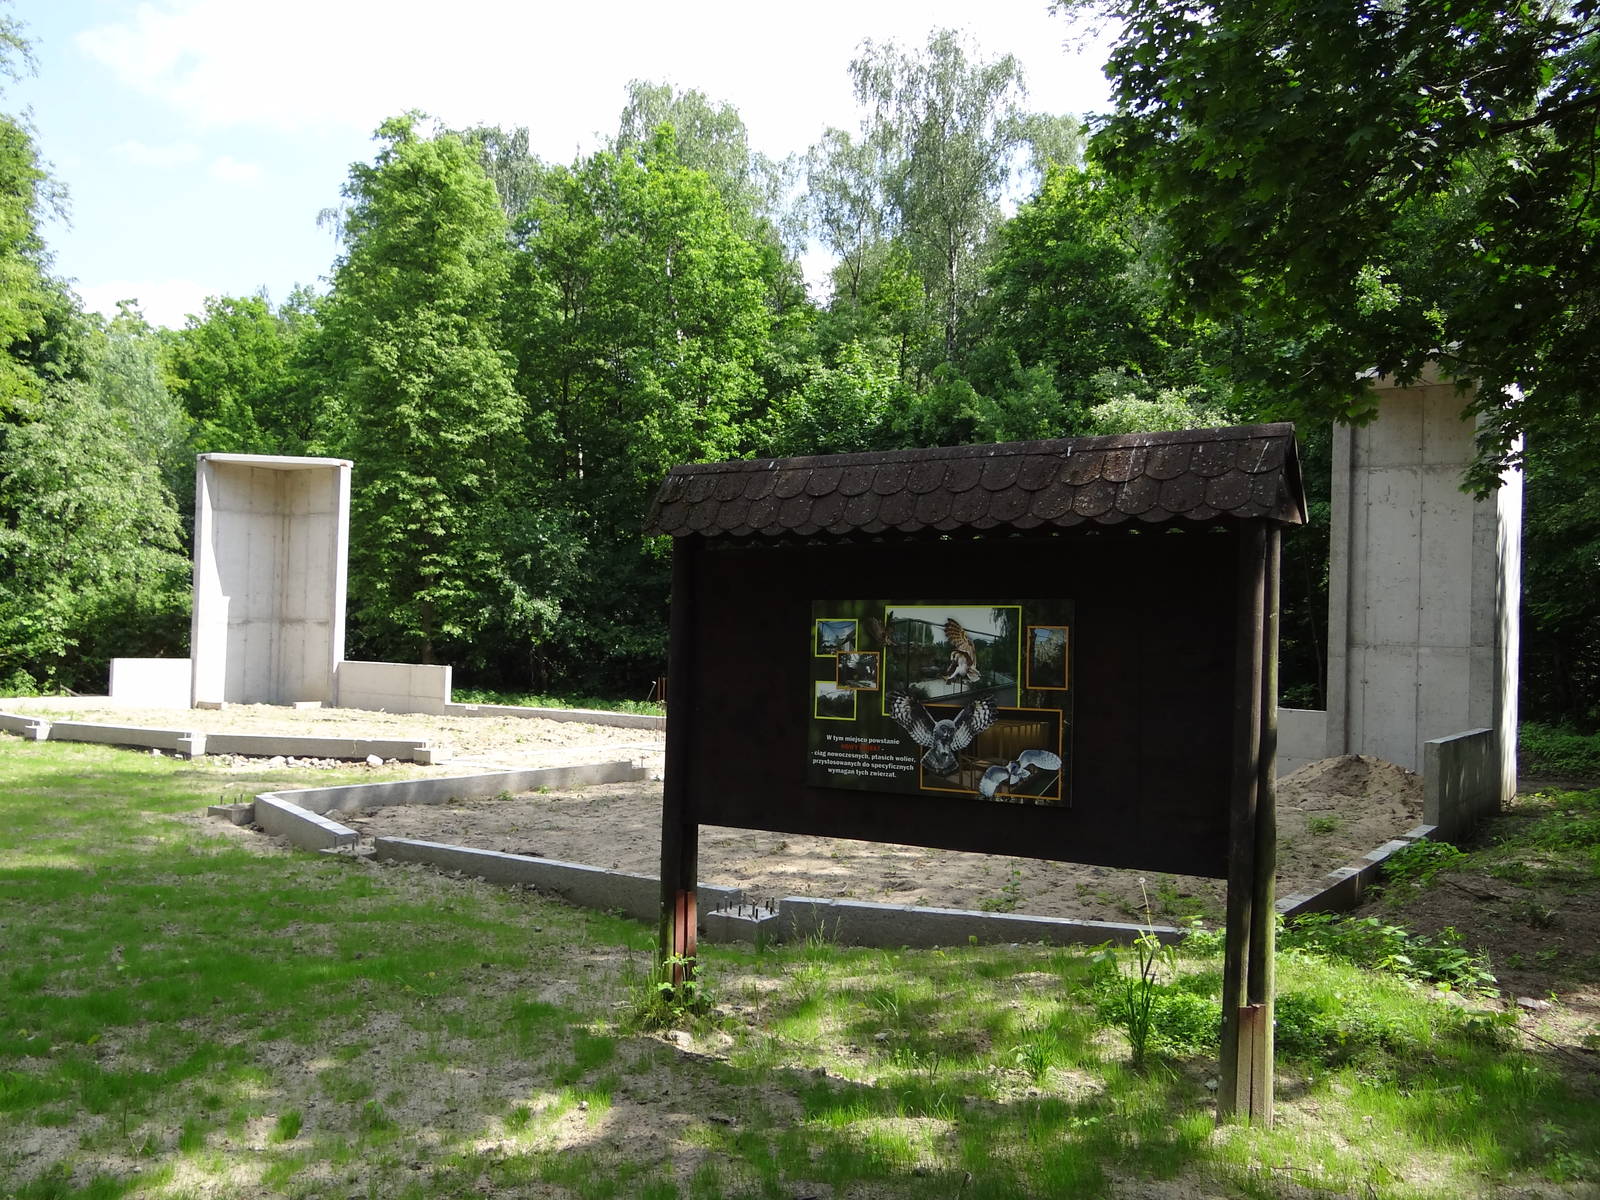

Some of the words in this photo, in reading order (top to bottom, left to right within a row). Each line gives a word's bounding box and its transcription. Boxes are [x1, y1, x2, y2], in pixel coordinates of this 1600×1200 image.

[871, 753, 894, 761] ptasich
[812, 758, 861, 767] przystosowanych
[870, 762, 914, 771] specyficznych
